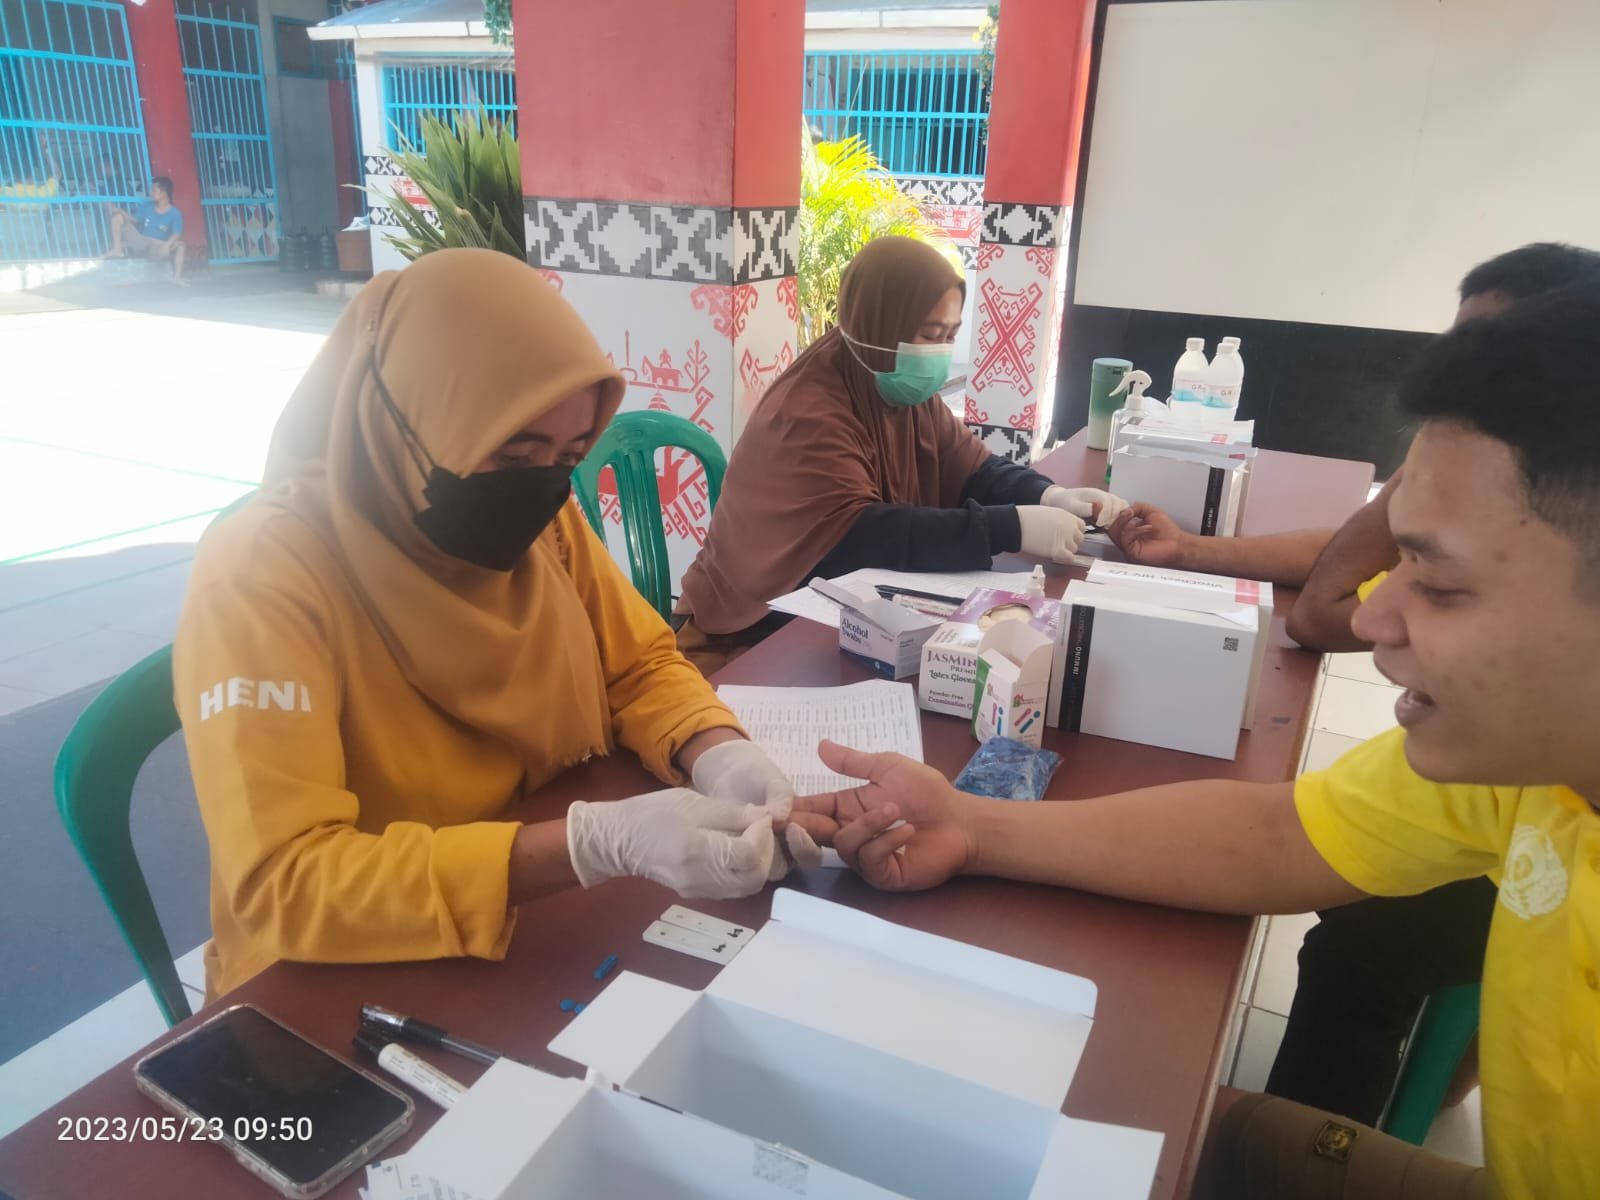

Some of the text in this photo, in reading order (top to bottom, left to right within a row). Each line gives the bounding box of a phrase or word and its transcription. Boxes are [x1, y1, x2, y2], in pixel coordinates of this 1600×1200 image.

[842, 617, 869, 640] Alcohol
[842, 626, 862, 644] Swabs
[1072, 646, 1082, 675] IMMUNO
[929, 669, 949, 680] Latex
[200, 677, 312, 721] HENI
